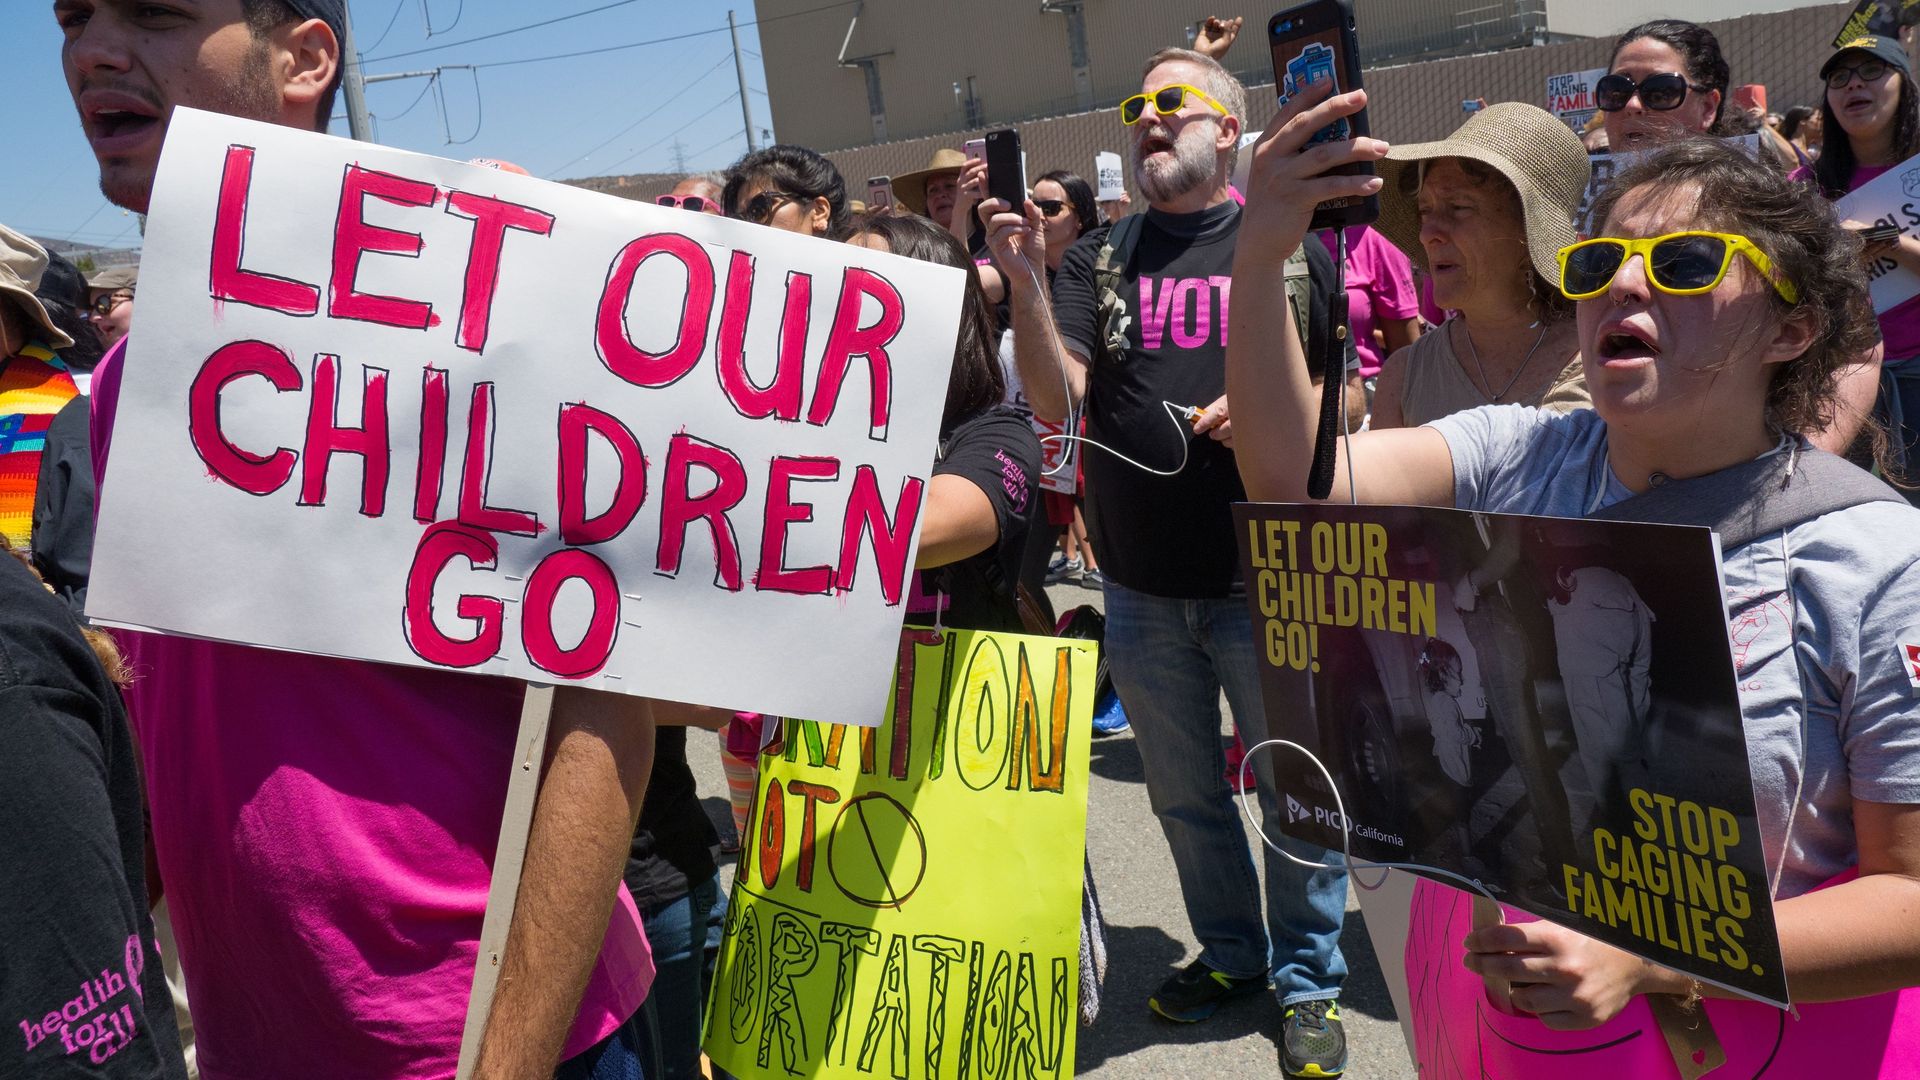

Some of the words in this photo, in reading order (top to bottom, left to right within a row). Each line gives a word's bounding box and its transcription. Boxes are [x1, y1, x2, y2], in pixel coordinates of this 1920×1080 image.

[1548, 74, 1574, 89] STOP
[209, 143, 557, 356] LET
[594, 231, 906, 441] OUR
[1139, 274, 1233, 349] VOT
[189, 338, 925, 607] CHILDREN
[994, 448, 1028, 490] health
[1001, 464, 1018, 484] for
[1248, 519, 1301, 571] LET
[1311, 521, 1389, 577] OUR
[402, 518, 622, 680] GO
[1257, 568, 1437, 638] CHILDREN
[1265, 618, 1321, 673] GO!
[1314, 806, 1353, 833] PICO
[1355, 823, 1404, 847] California
[1629, 787, 1741, 862] STOP
[1593, 827, 1752, 920] CAGING
[1562, 863, 1764, 977] FAMILIES.
[18, 968, 126, 1052] health
[59, 1012, 108, 1055] for
[89, 1004, 137, 1064] all
